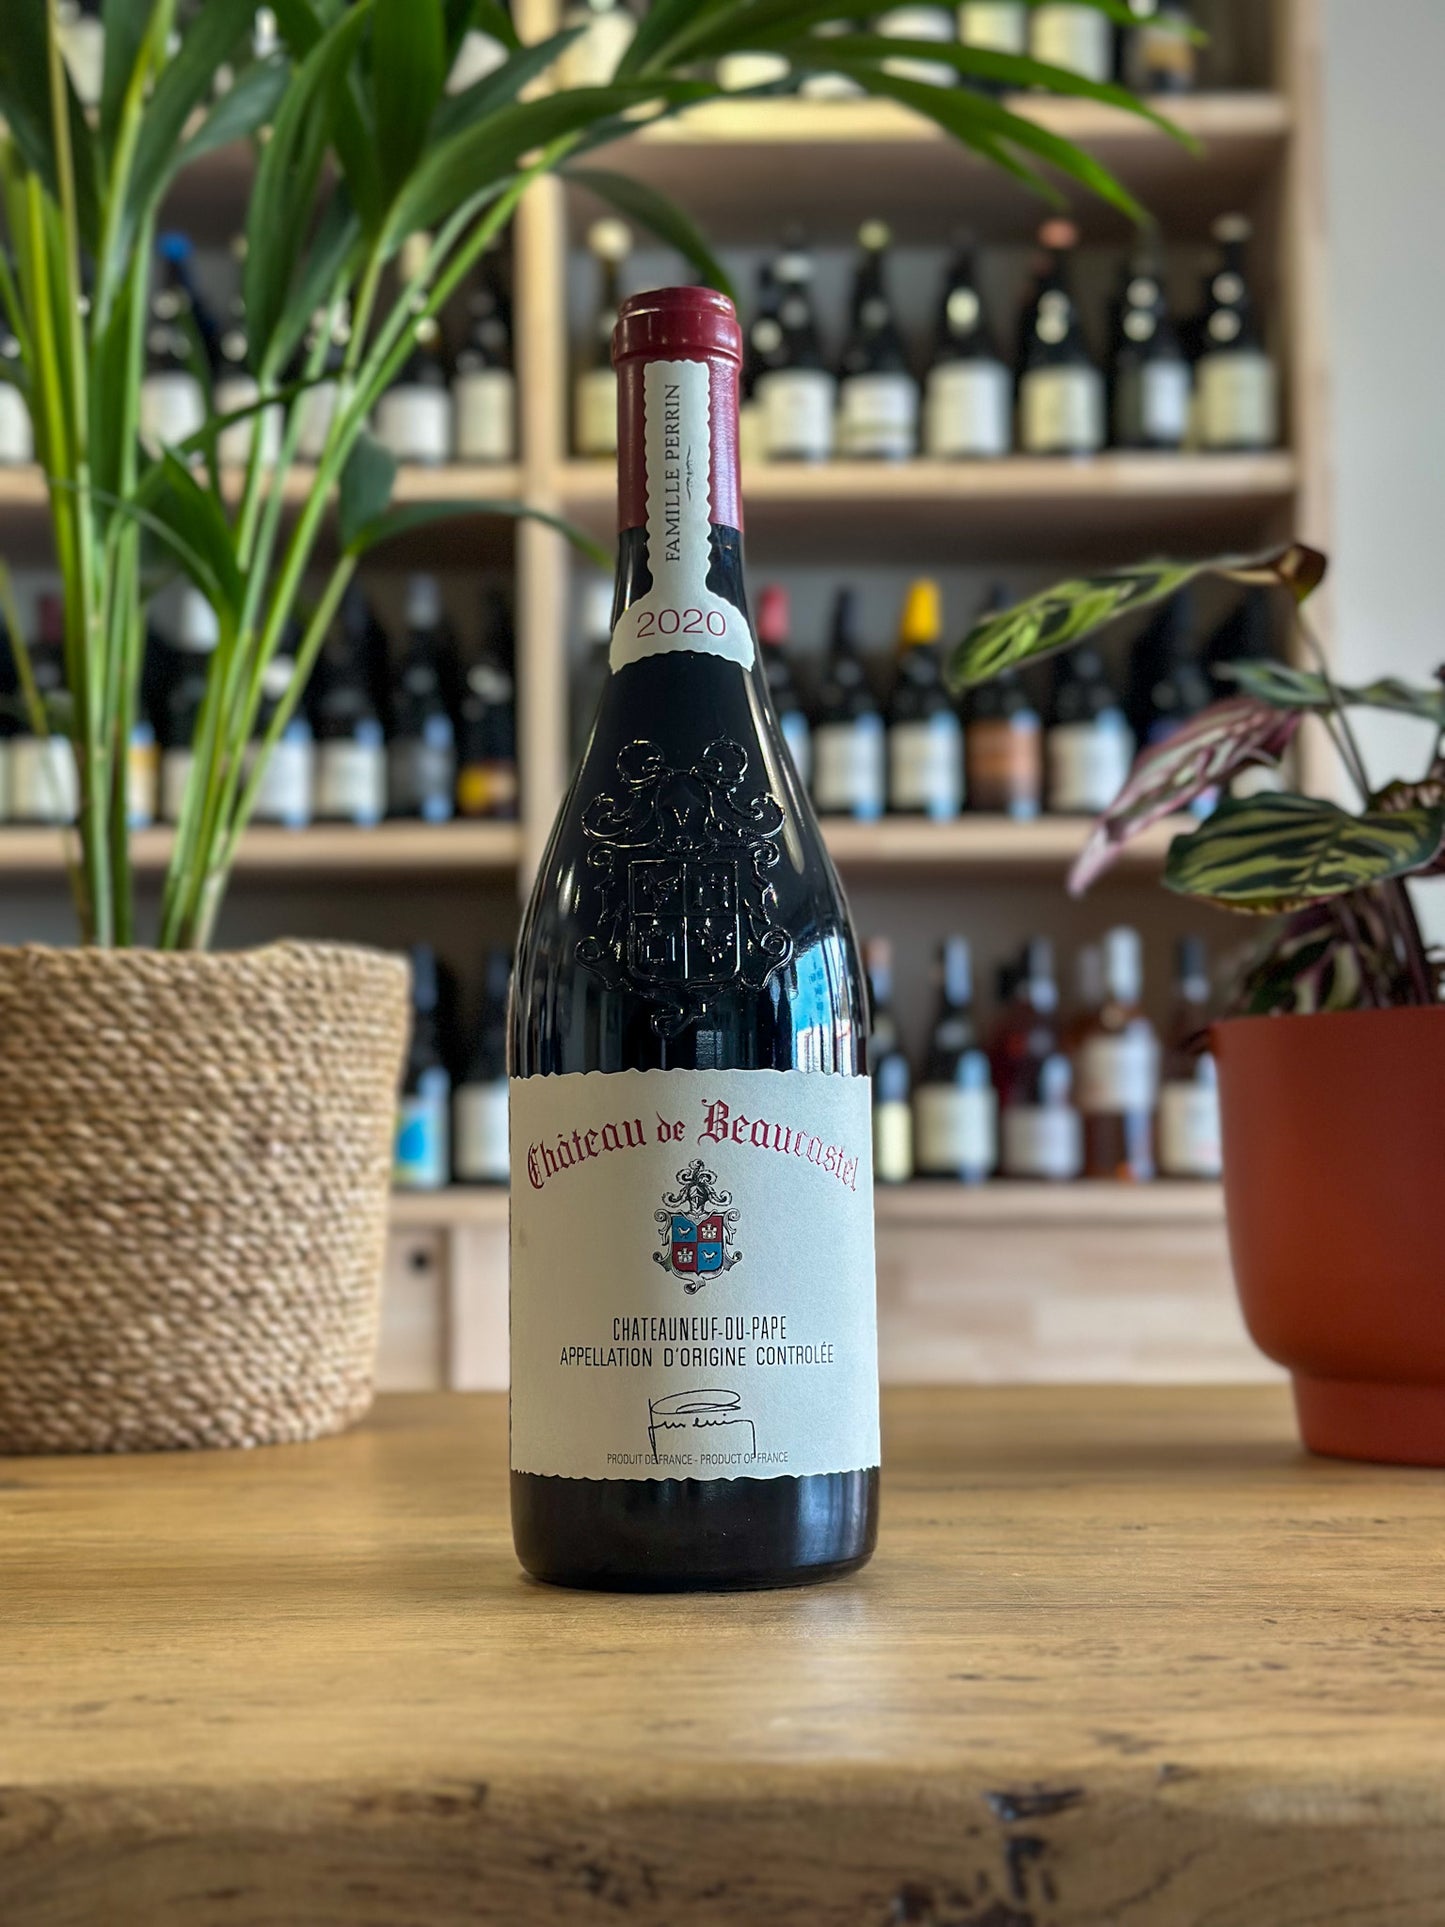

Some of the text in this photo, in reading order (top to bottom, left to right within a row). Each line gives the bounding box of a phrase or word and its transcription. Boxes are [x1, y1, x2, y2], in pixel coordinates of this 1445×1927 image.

[664, 383, 681, 563] FAMILLE PERRIN
[636, 608, 727, 638] 2020
[527, 1098, 858, 1192] Château de Beaucastel
[613, 1316, 787, 1341] CHATEAUNEUF-DU-PAPE
[560, 1341, 834, 1367] APPELLATION D'ORIGINE CONTROLÉE
[607, 1452, 642, 1465] PRODUIT
[644, 1453, 657, 1465] DE
[658, 1453, 693, 1465] FRANCE
[700, 1452, 741, 1465] PRODUCT
[743, 1452, 756, 1464] OF
[757, 1451, 789, 1464] FRANCE
